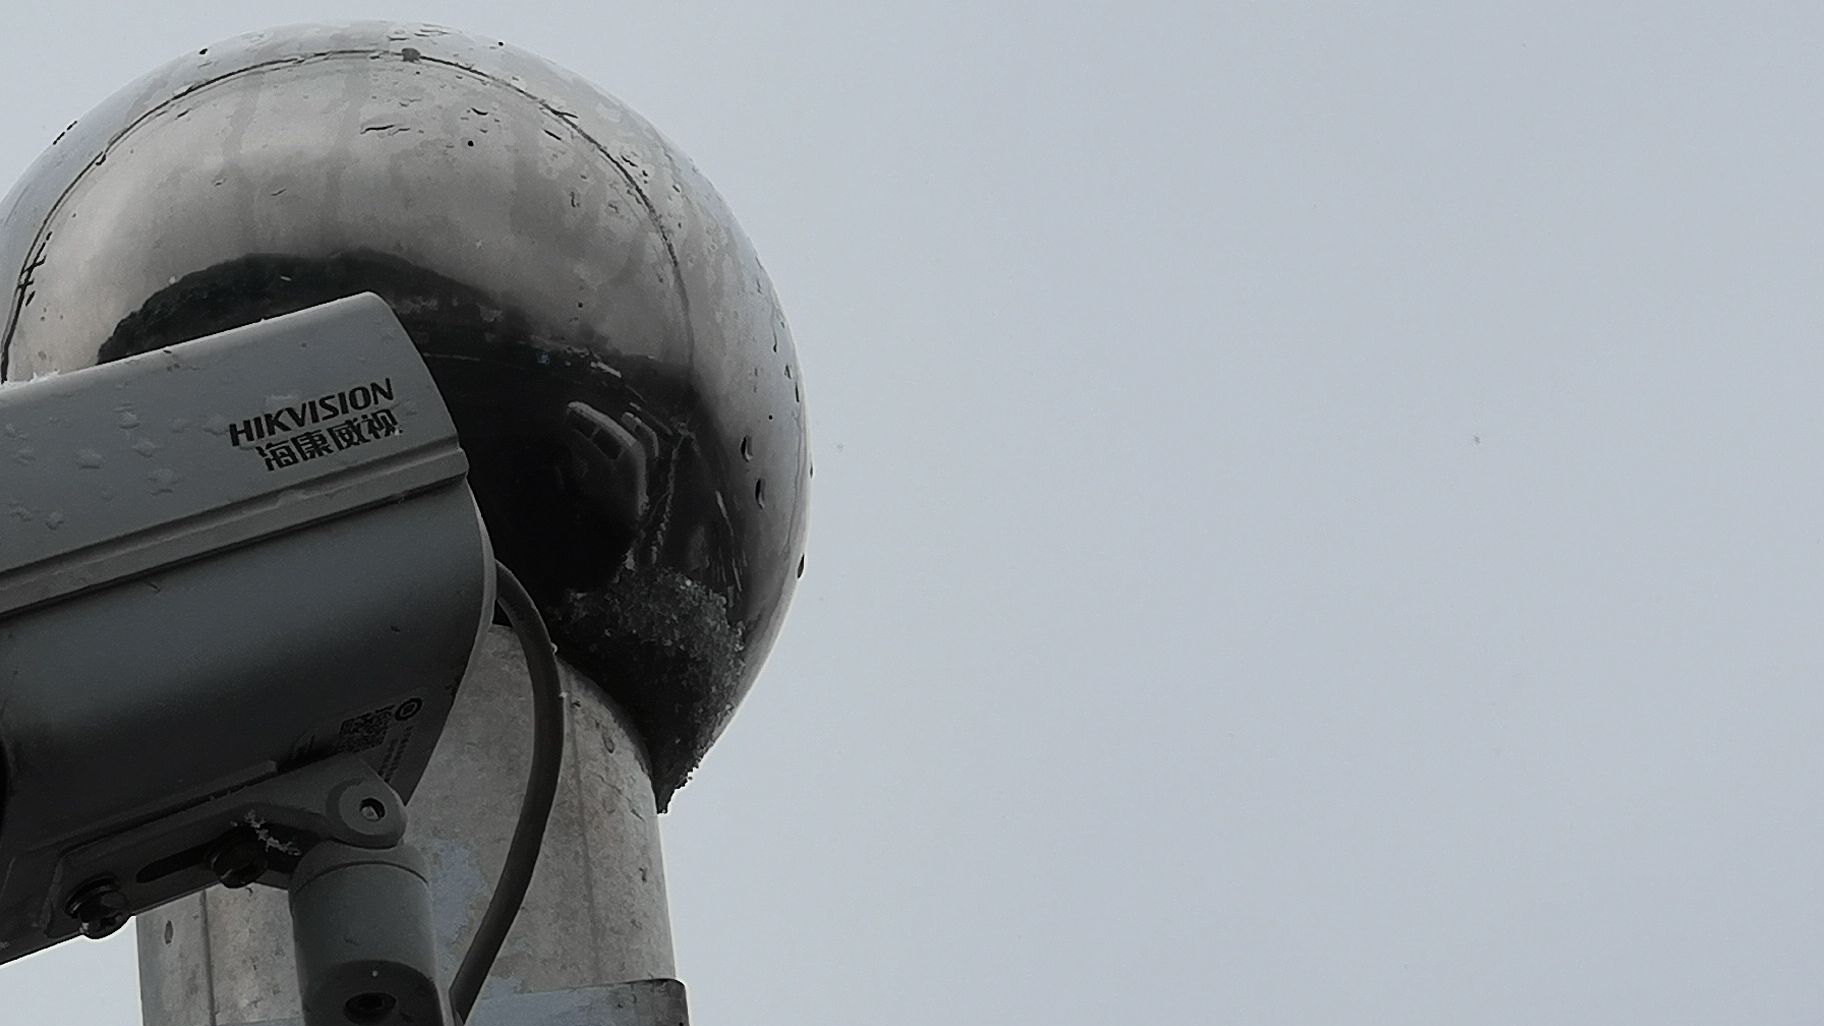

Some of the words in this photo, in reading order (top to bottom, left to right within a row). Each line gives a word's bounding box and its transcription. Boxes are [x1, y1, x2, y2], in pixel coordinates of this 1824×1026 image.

[229, 378, 394, 447] HIKVISION
[255, 409, 403, 471] 海康威视
